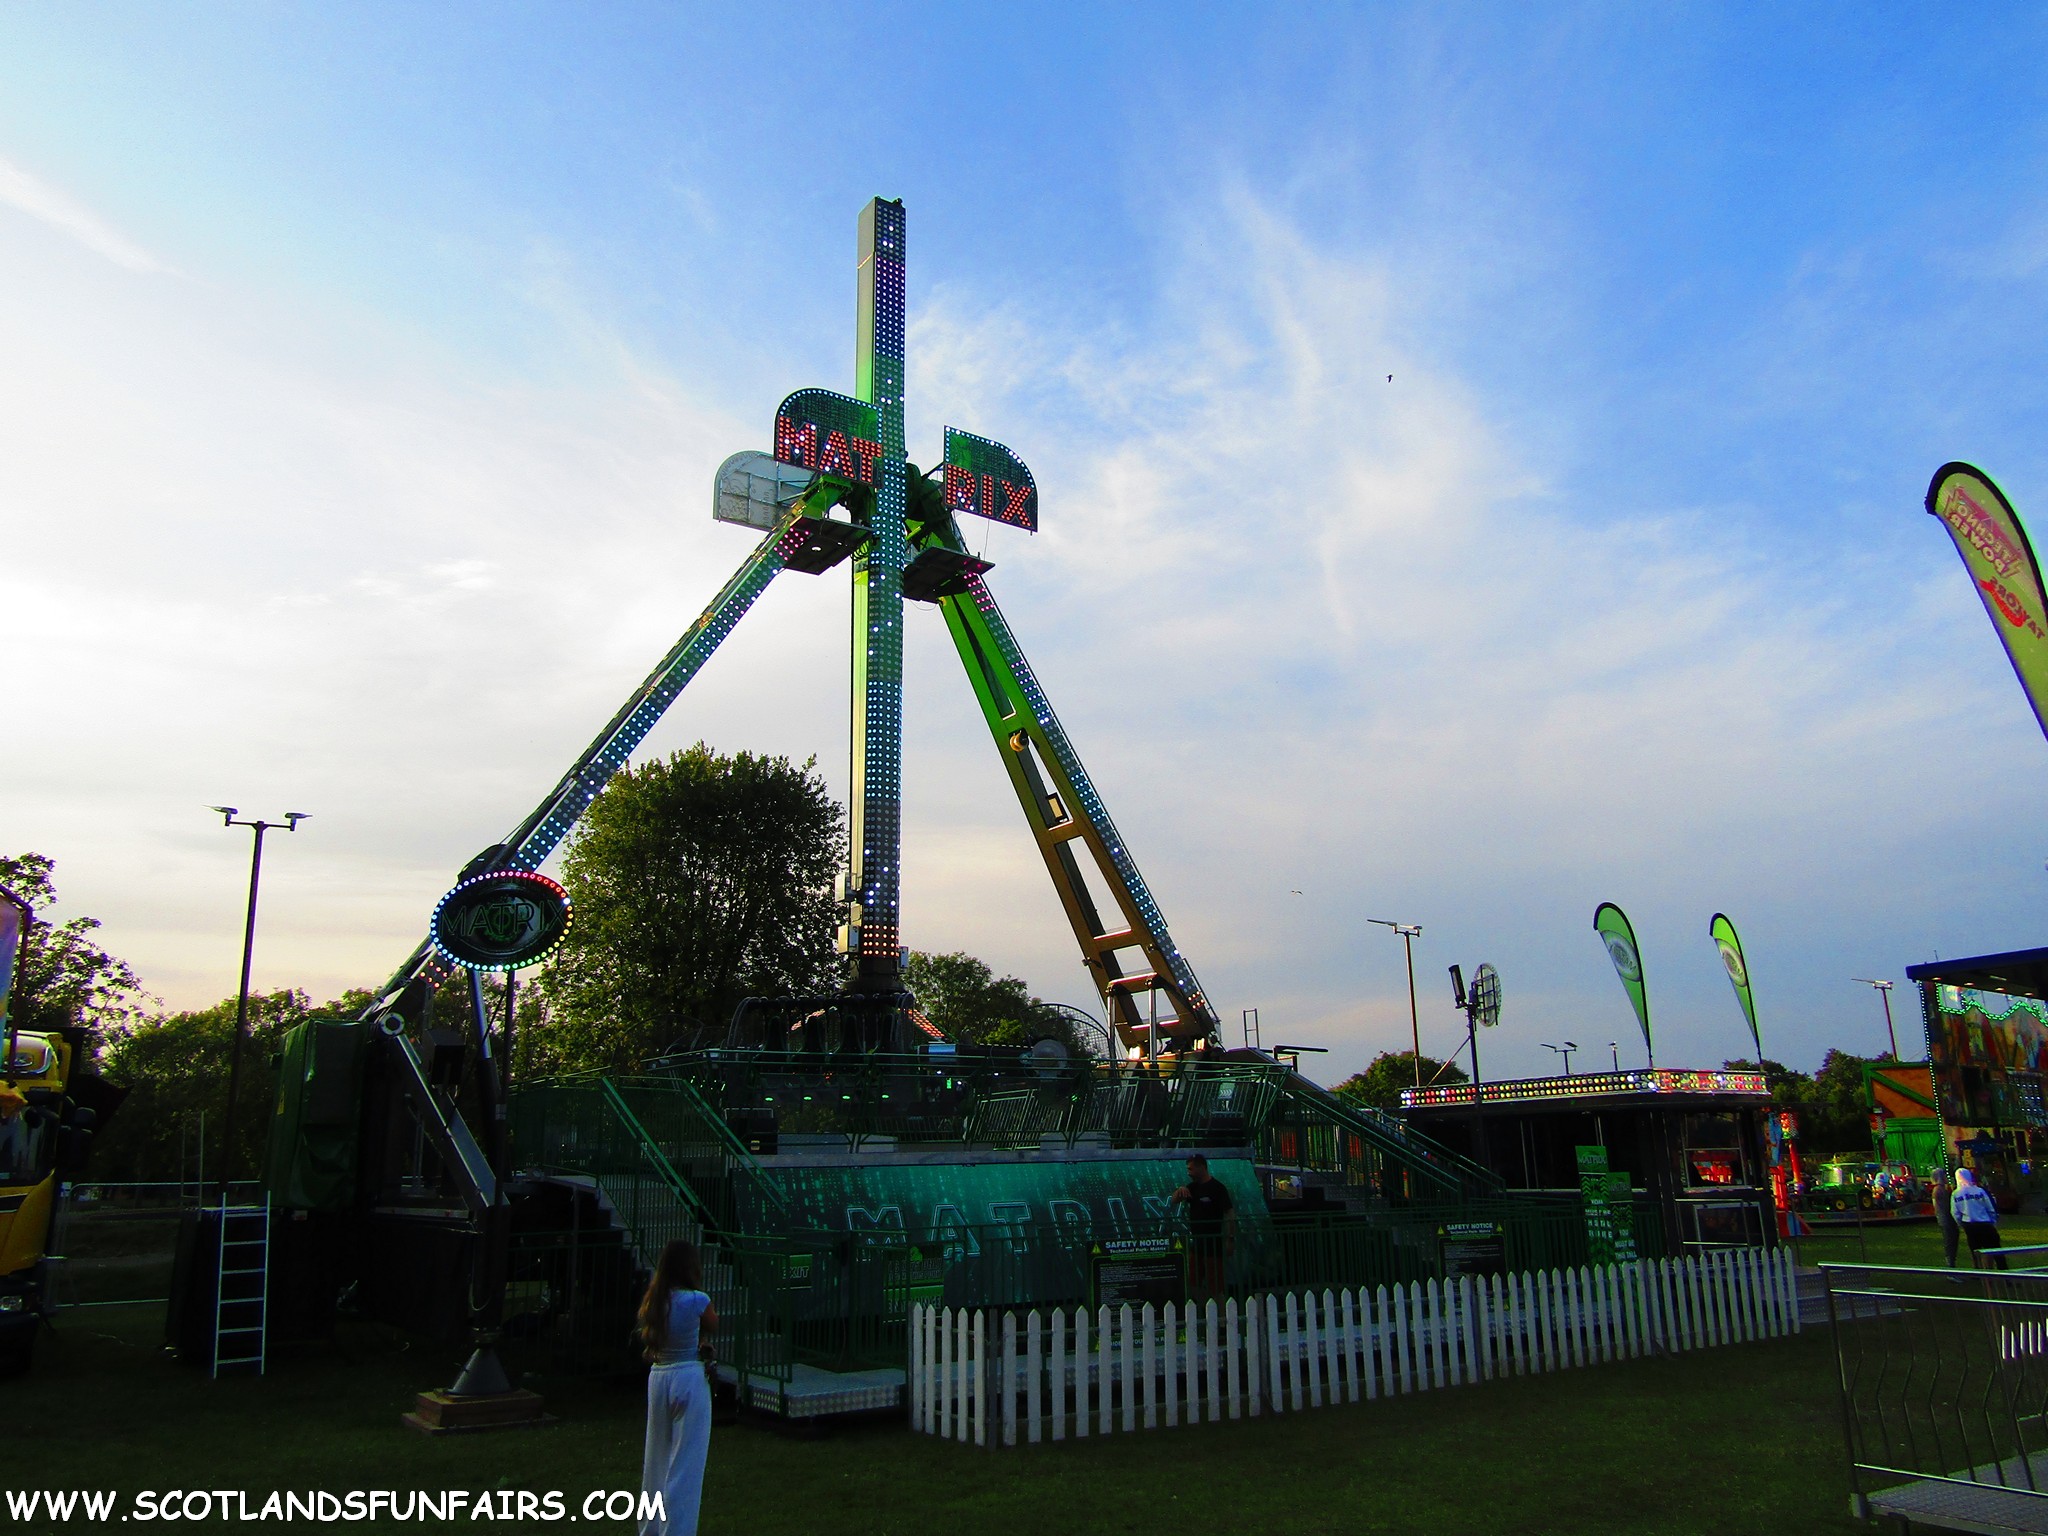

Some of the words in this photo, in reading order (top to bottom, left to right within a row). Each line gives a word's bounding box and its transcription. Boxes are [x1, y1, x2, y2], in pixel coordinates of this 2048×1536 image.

[777, 415, 883, 484] MAT
[945, 463, 1033, 528] RIX
[438, 899, 567, 937] MATRIX
[846, 1195, 1192, 1262] MATRIX
[1105, 1240, 1137, 1249] SAFETY
[1139, 1238, 1170, 1247] NOTICE
